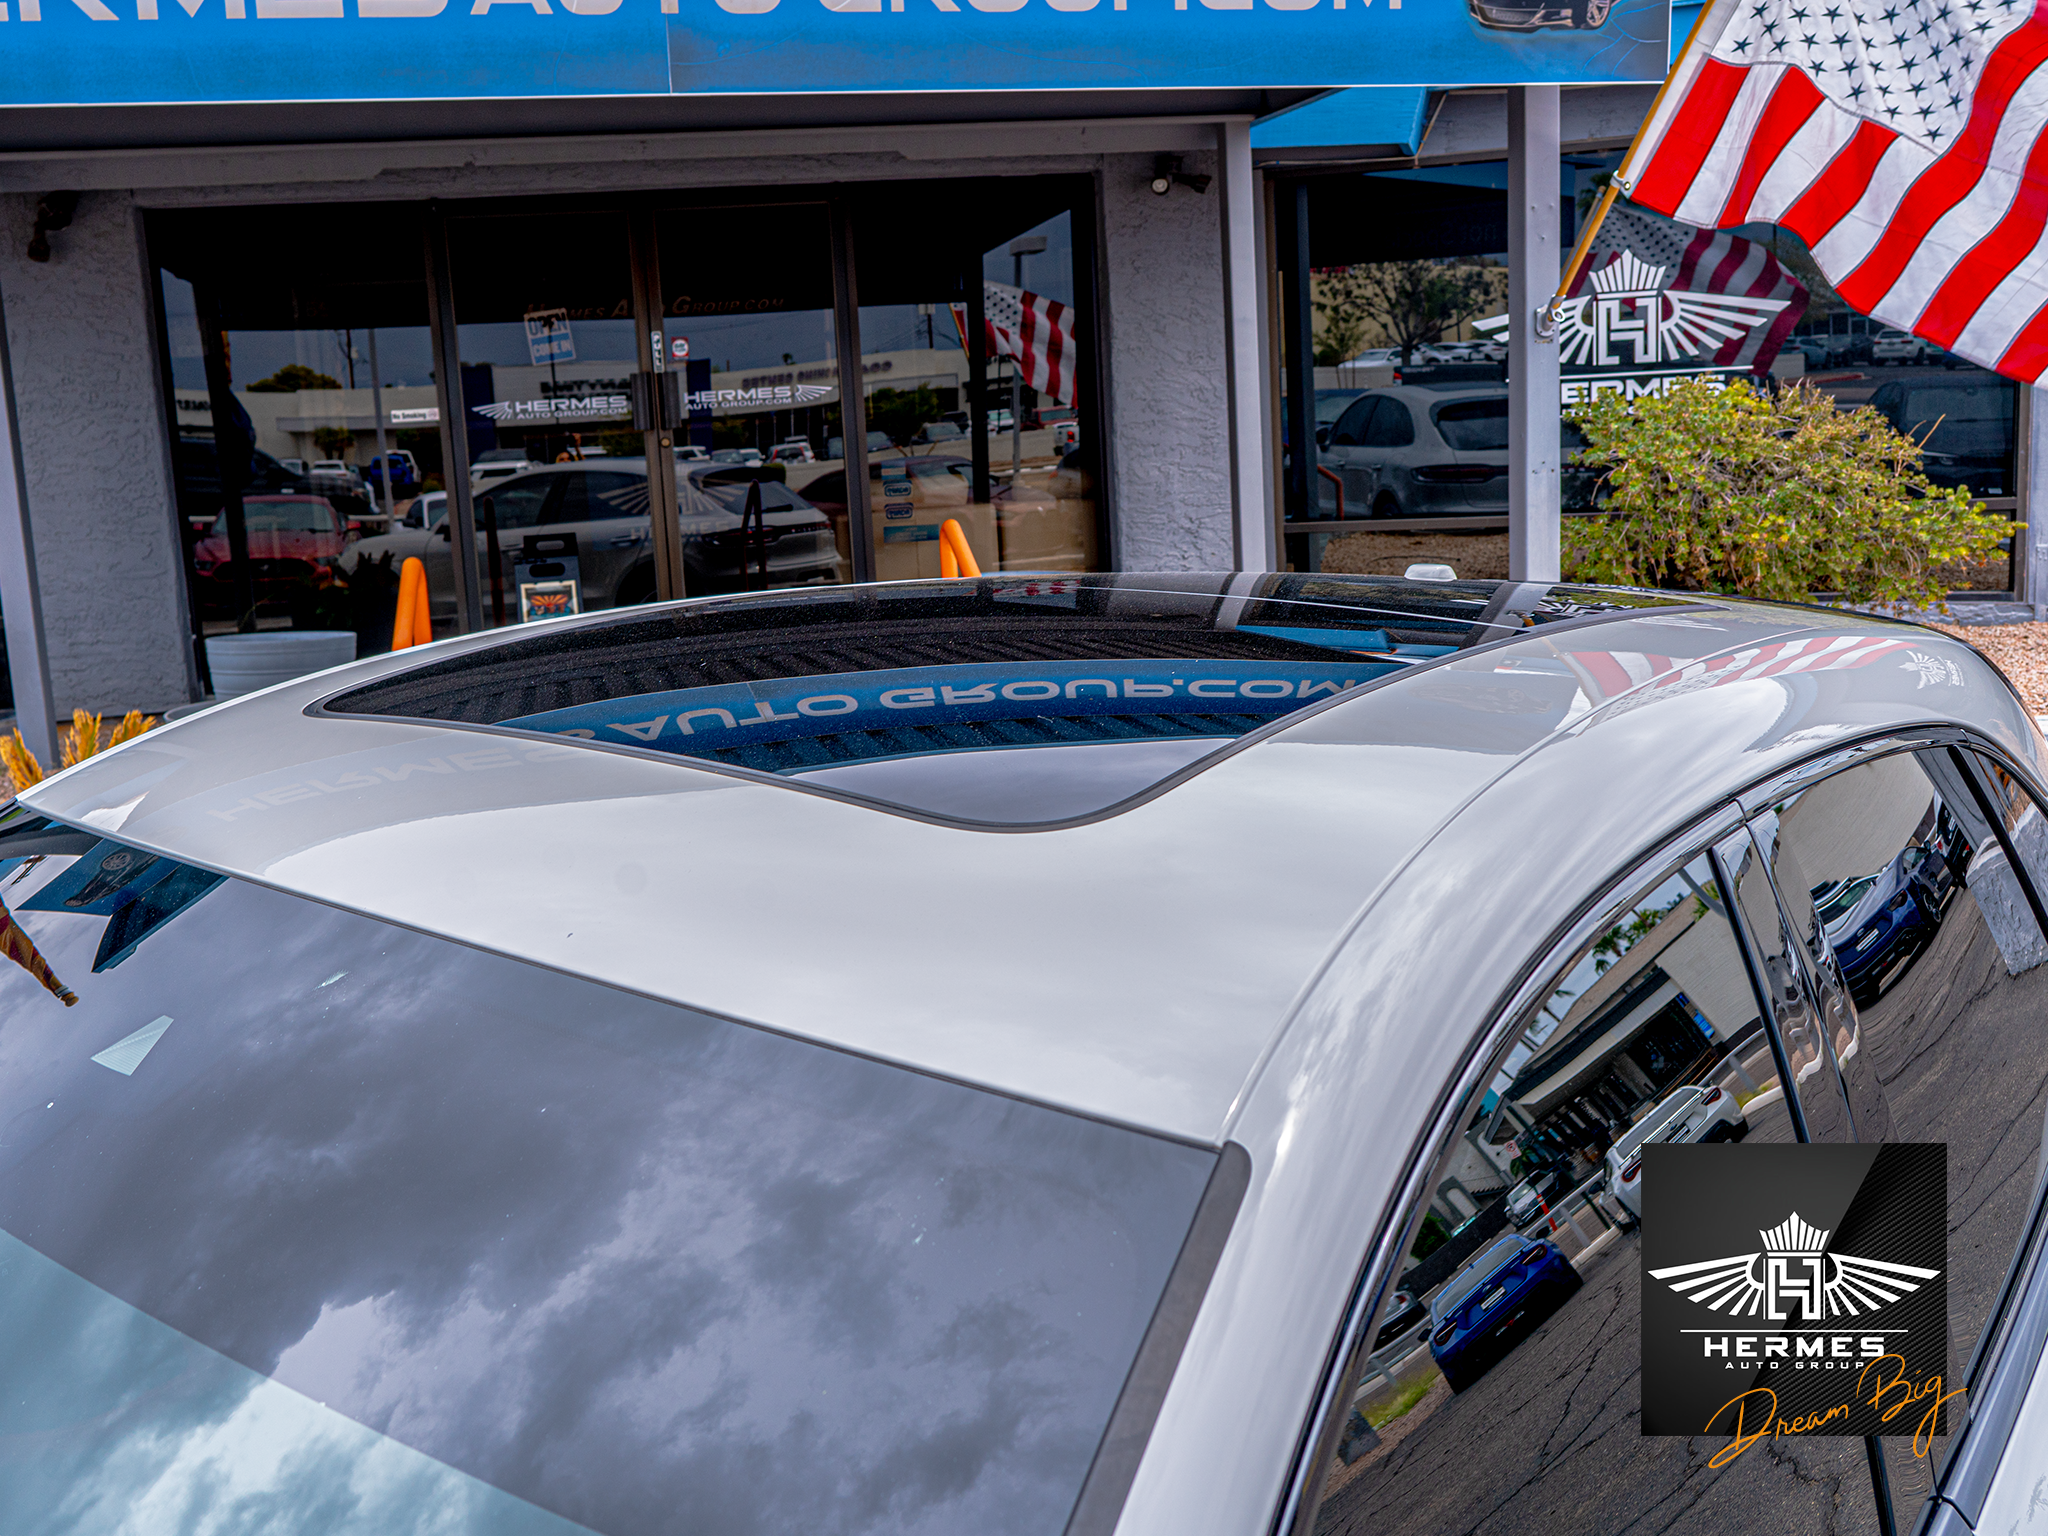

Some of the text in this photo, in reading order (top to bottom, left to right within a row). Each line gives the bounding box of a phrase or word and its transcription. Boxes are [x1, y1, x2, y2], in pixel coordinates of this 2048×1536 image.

[528, 313, 568, 336] OPEN
[533, 339, 572, 357] COME IN
[653, 332, 663, 368] PULL
[684, 386, 791, 403] HERMES
[515, 395, 628, 414] HERMES
[516, 407, 628, 420] AUTO GROUP.COM
[684, 398, 792, 411] AUTO GROUP.COM
